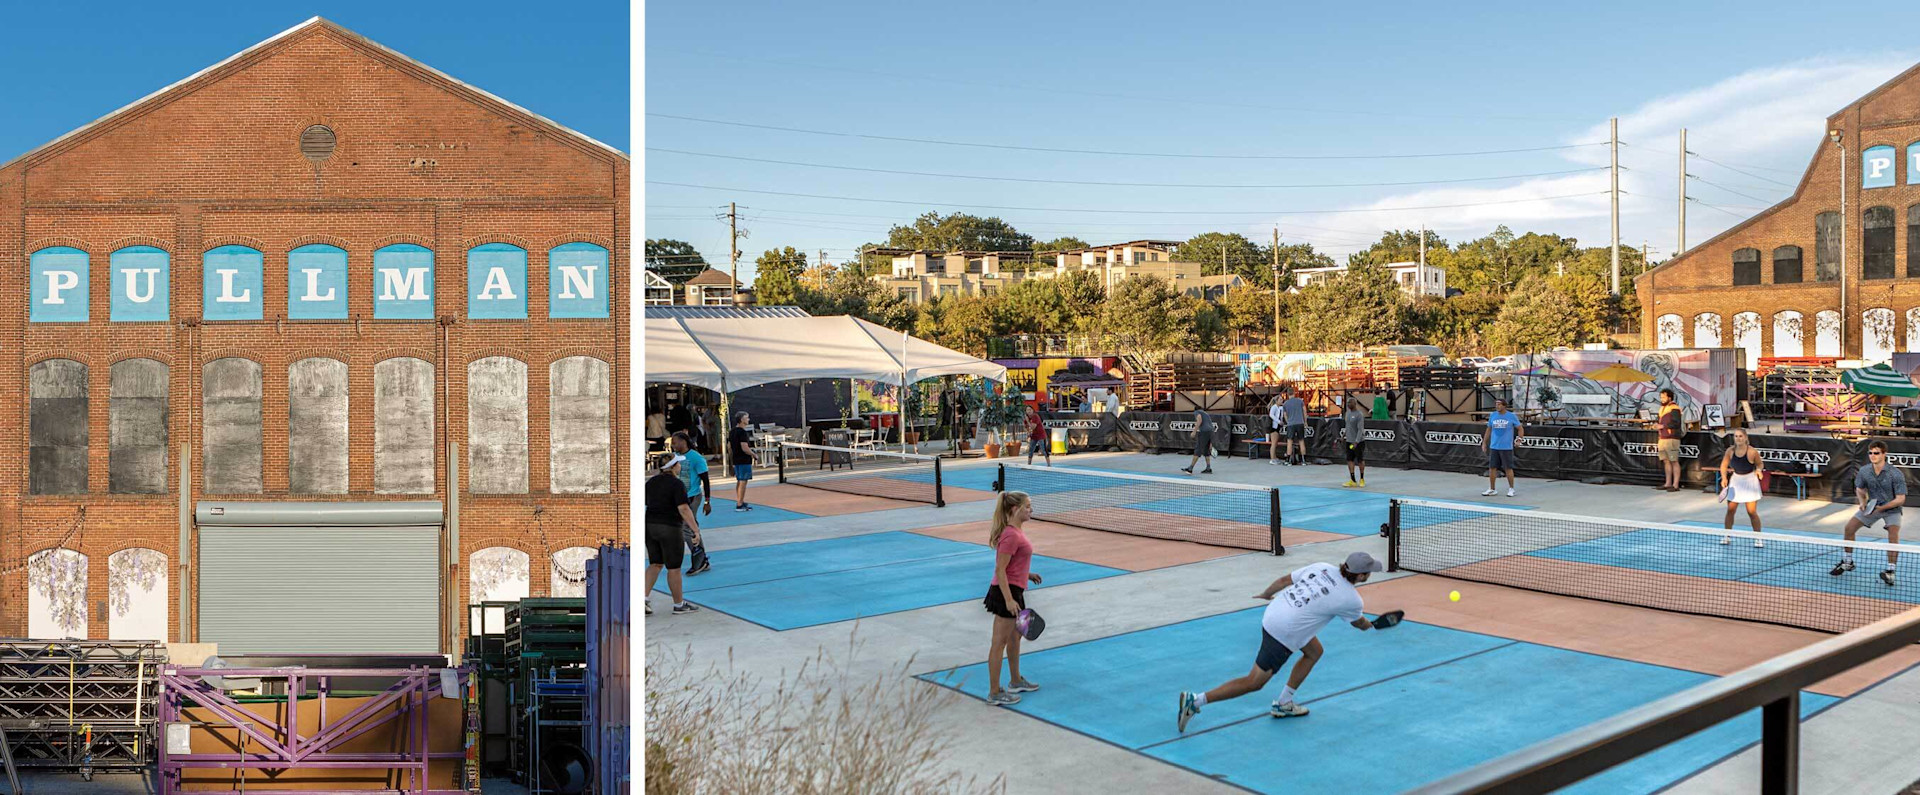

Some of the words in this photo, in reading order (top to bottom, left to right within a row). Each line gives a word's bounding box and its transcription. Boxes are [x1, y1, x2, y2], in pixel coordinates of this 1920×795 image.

[42, 265, 598, 305] PULLMAN
[1045, 420, 1098, 428] PULLMAN
[1428, 433, 1480, 444] PULLMAN
[1519, 438, 1581, 448] PULLMAN
[1758, 450, 1825, 462] ULLMAN
